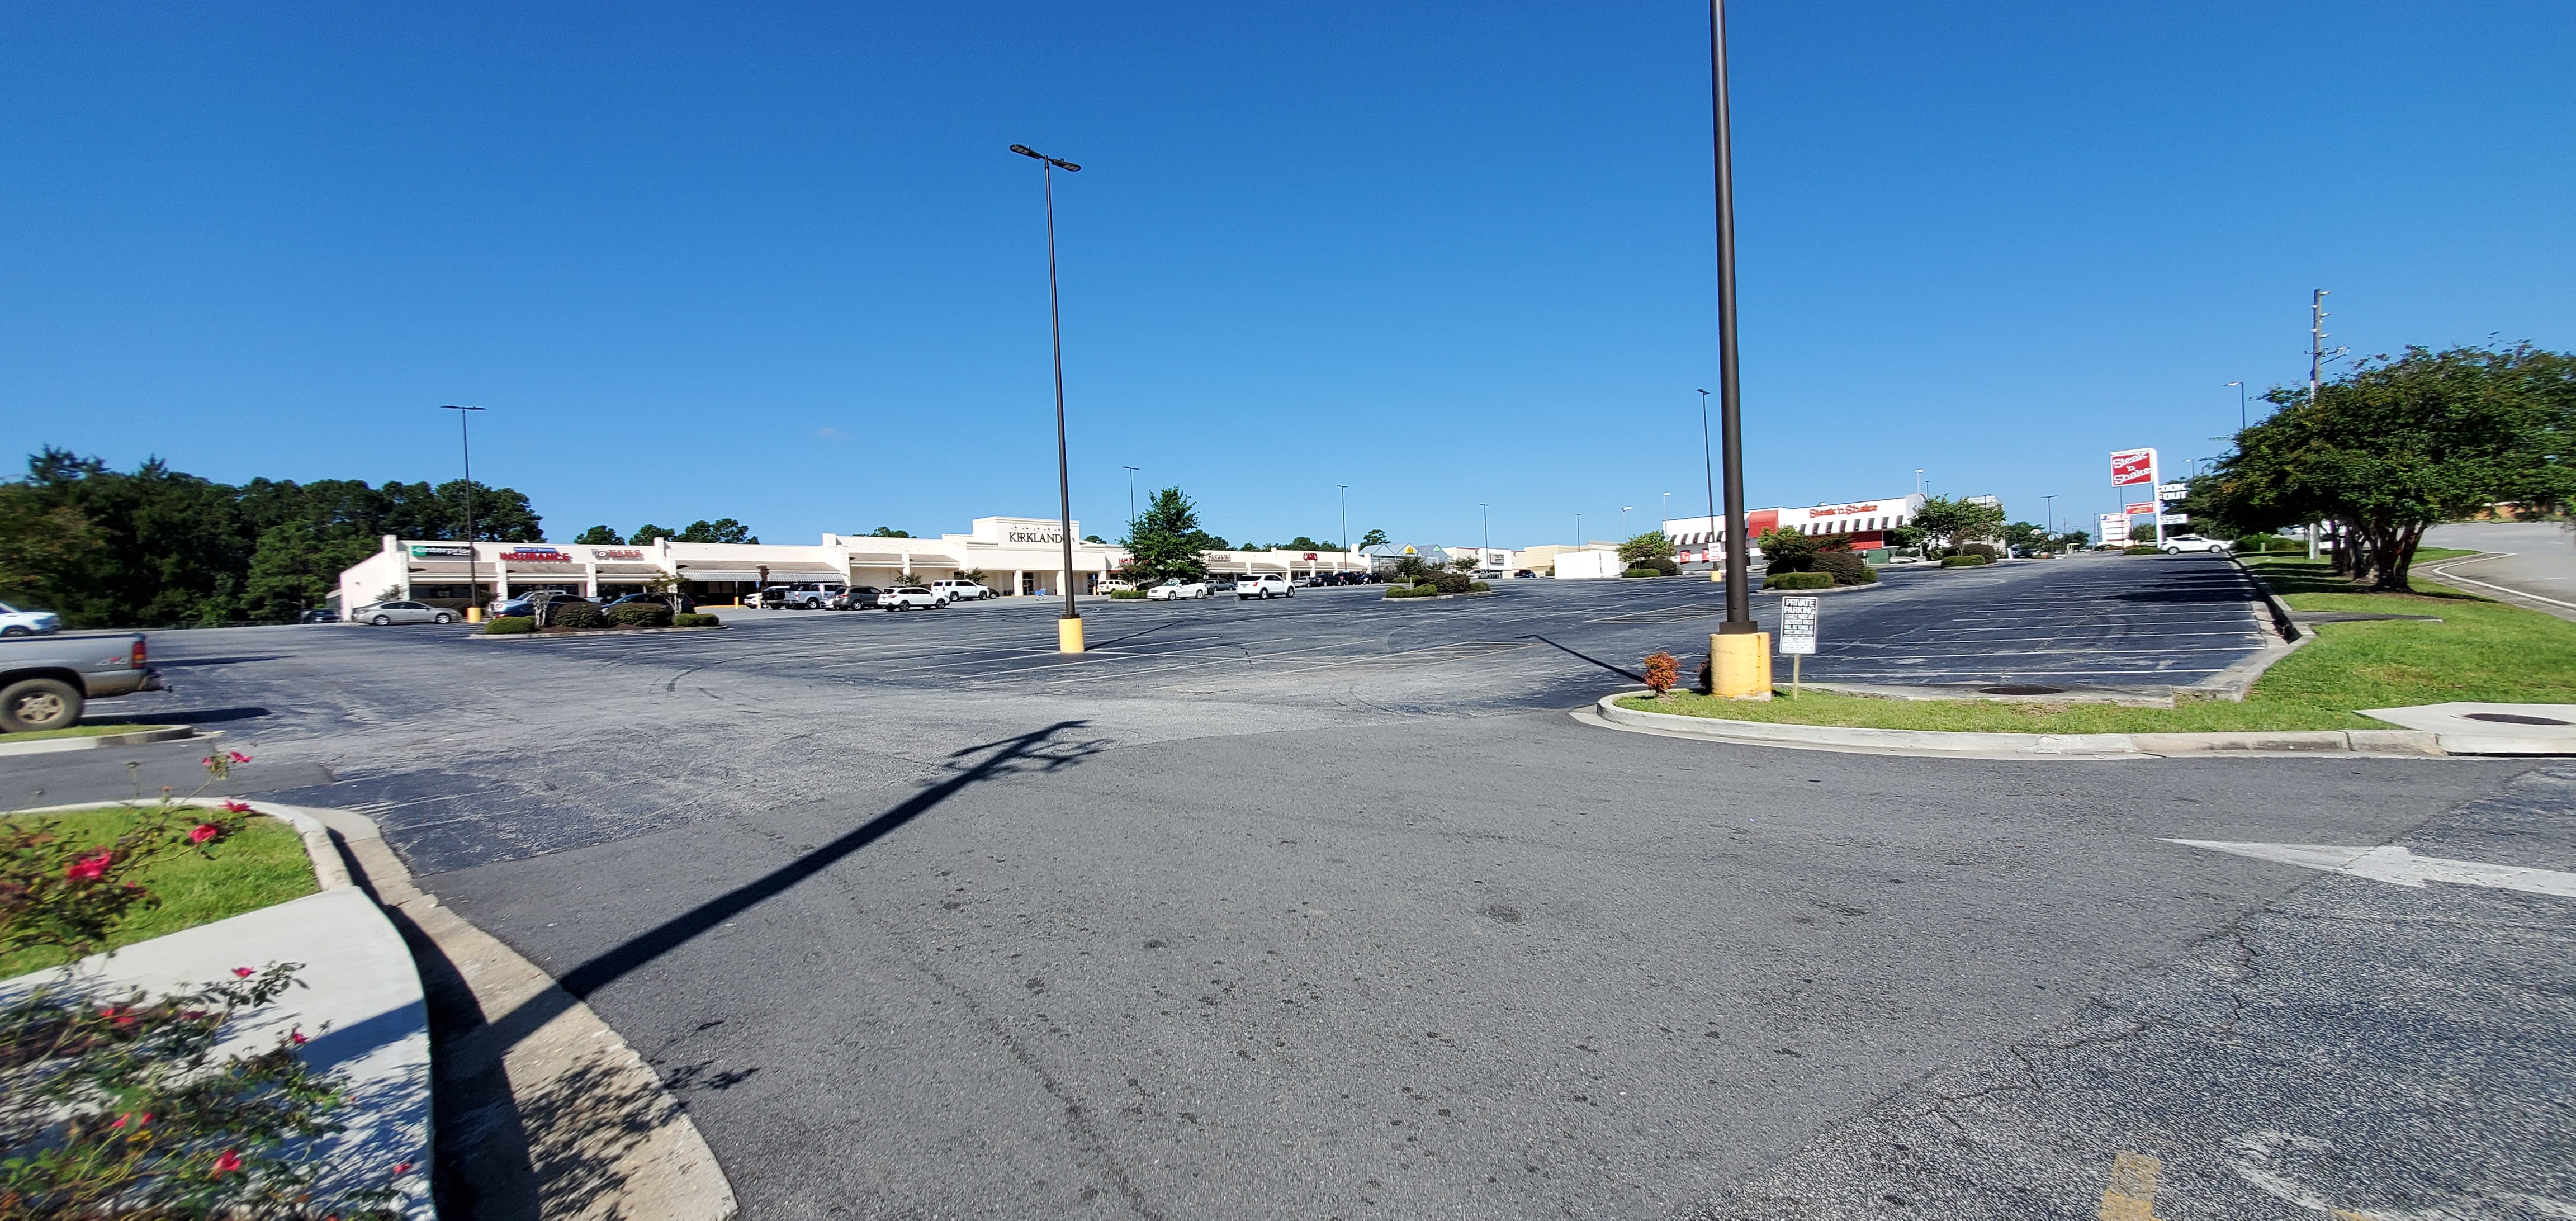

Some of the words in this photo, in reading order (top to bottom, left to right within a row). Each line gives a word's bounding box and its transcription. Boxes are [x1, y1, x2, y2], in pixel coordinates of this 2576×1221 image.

[2112, 452, 2148, 469] Steak
[2113, 467, 2151, 485] Shake
[2163, 491, 2188, 500] OUT
[1809, 508, 1836, 518] Steak
[1008, 532, 1063, 543] KIRKLAND
[499, 551, 570, 561] INSURANCE
